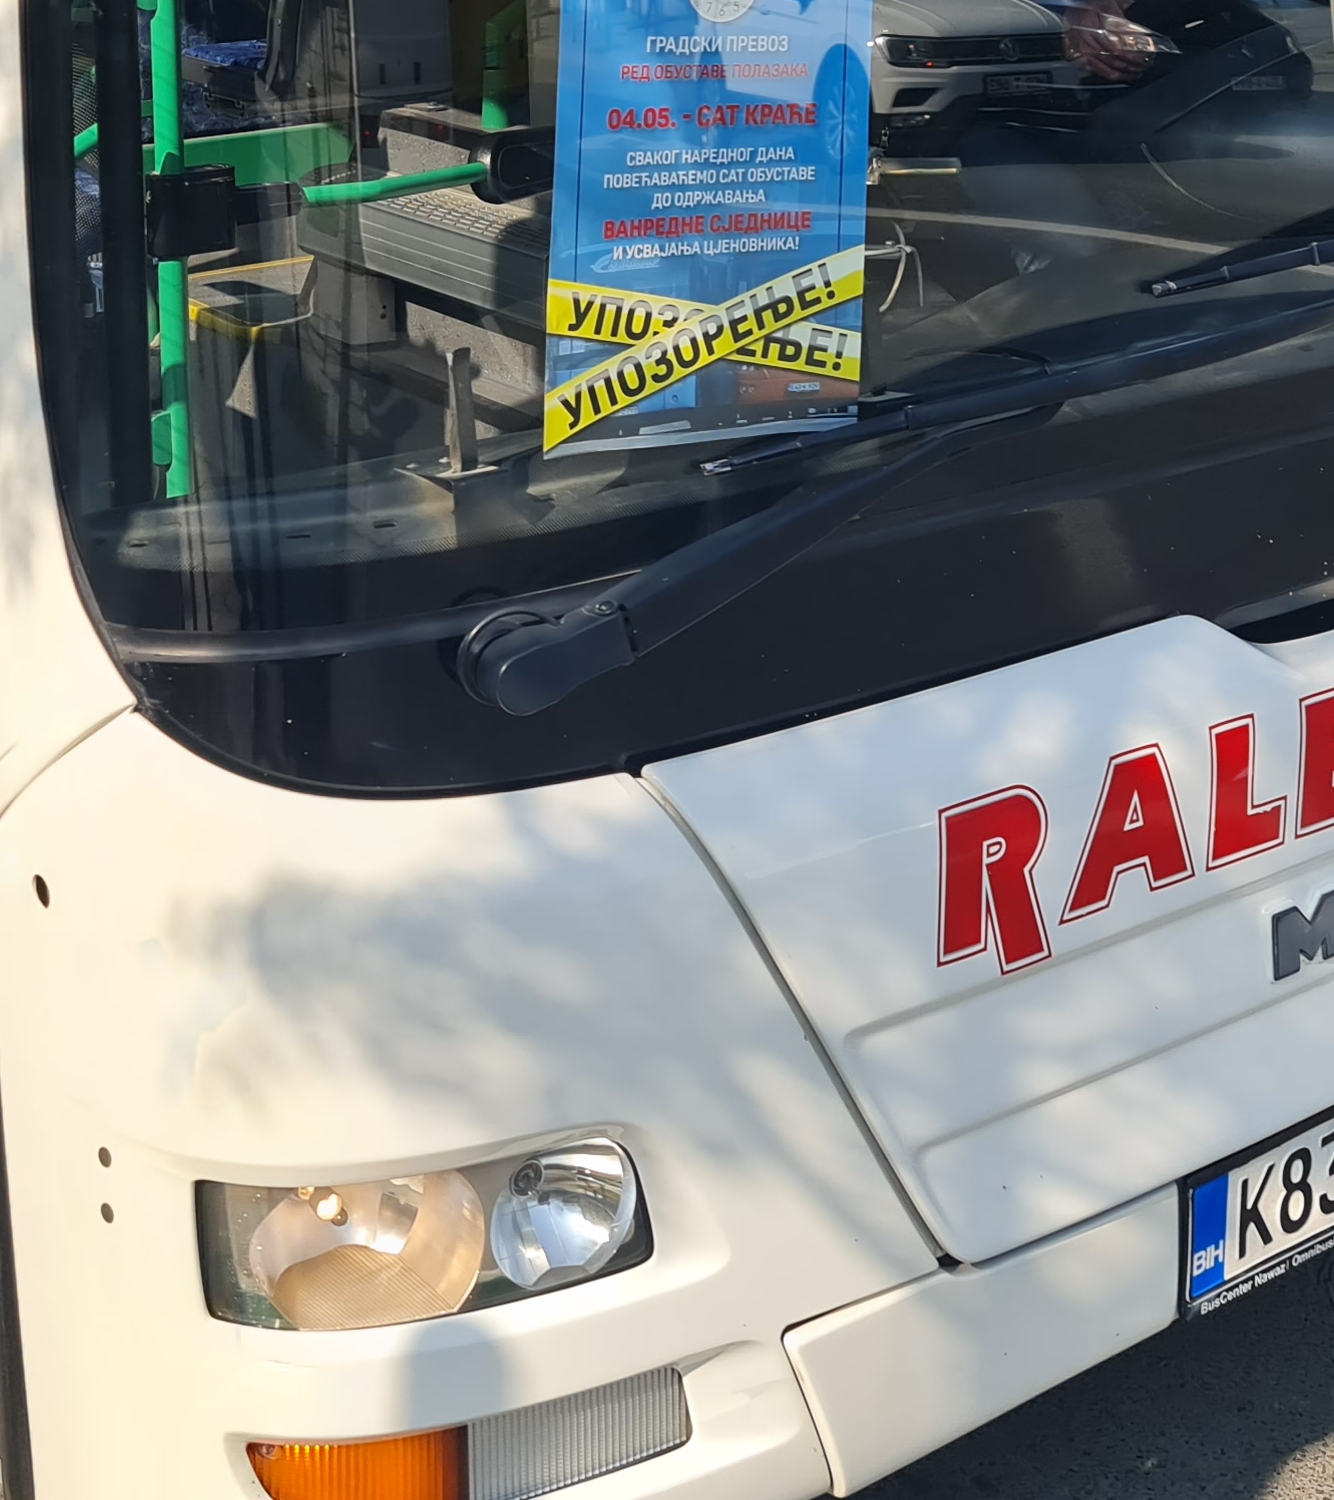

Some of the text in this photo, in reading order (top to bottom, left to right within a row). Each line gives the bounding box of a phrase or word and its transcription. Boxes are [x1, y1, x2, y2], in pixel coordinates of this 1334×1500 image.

[646, 34, 789, 55] ГРАДСКИ ПРЕВОЗ
[621, 62, 809, 82] РЕД ОБУСТАВЕ ПОЛАЗАКА
[607, 107, 677, 130] 04.05.
[696, 103, 740, 128] САТ
[744, 101, 818, 126] КРАЋЕ
[626, 146, 795, 166] СВАКОГ НАРЕДНОГ ДАНА
[603, 166, 816, 189] ПОВЕЋАВАЋЕМО САТ ОБУСТАВЕ
[651, 189, 766, 210] ДО ОДРЖАВАЊА
[603, 211, 812, 240] ВАНРЕДНЕ СЈЕДНИЦЕ
[613, 236, 800, 260] И УСВАЈАЊА ЦЈЕНОВНИКА!
[556, 262, 837, 431] УПОЗОРЕЊЕ!
[1192, 1239, 1224, 1277] BIH
[1200, 1279, 1253, 1315] BusCenter
